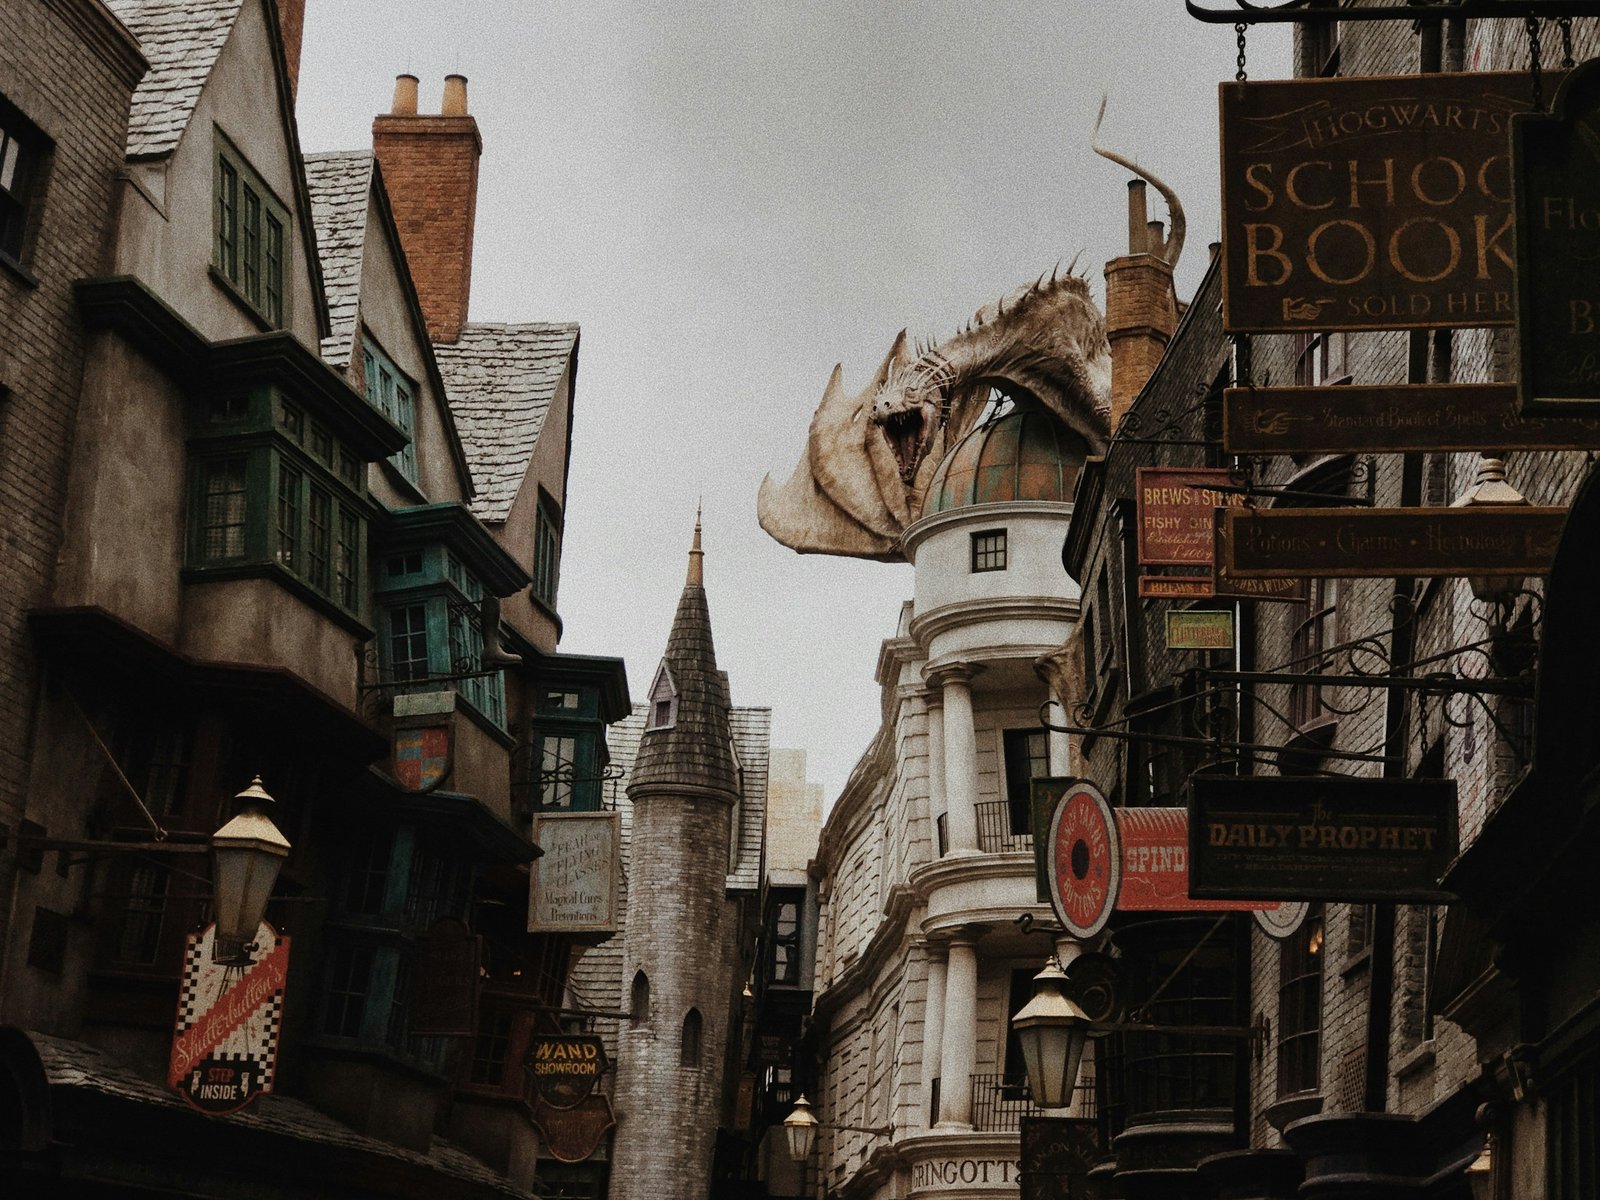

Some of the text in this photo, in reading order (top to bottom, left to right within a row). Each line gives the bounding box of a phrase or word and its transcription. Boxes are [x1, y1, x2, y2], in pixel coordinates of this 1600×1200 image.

[1314, 104, 1501, 139] HOGWARTS
[1242, 212, 1515, 288] BOOK
[1348, 294, 1432, 319] SOLD
[1144, 487, 1191, 506] BREWS
[1144, 516, 1182, 529] FISHY
[1207, 823, 1438, 851] DAILY PROPHET
[1126, 845, 1186, 873] SPIND
[545, 890, 578, 907] Magical
[1063, 877, 1102, 918] BUTTONS
[174, 962, 284, 1074] Shutterbutton's
[534, 1041, 598, 1060] WAND
[207, 1067, 236, 1084] STEP
[534, 1061, 597, 1075] SHOWROOM
[199, 1084, 239, 1101] INSIDE
